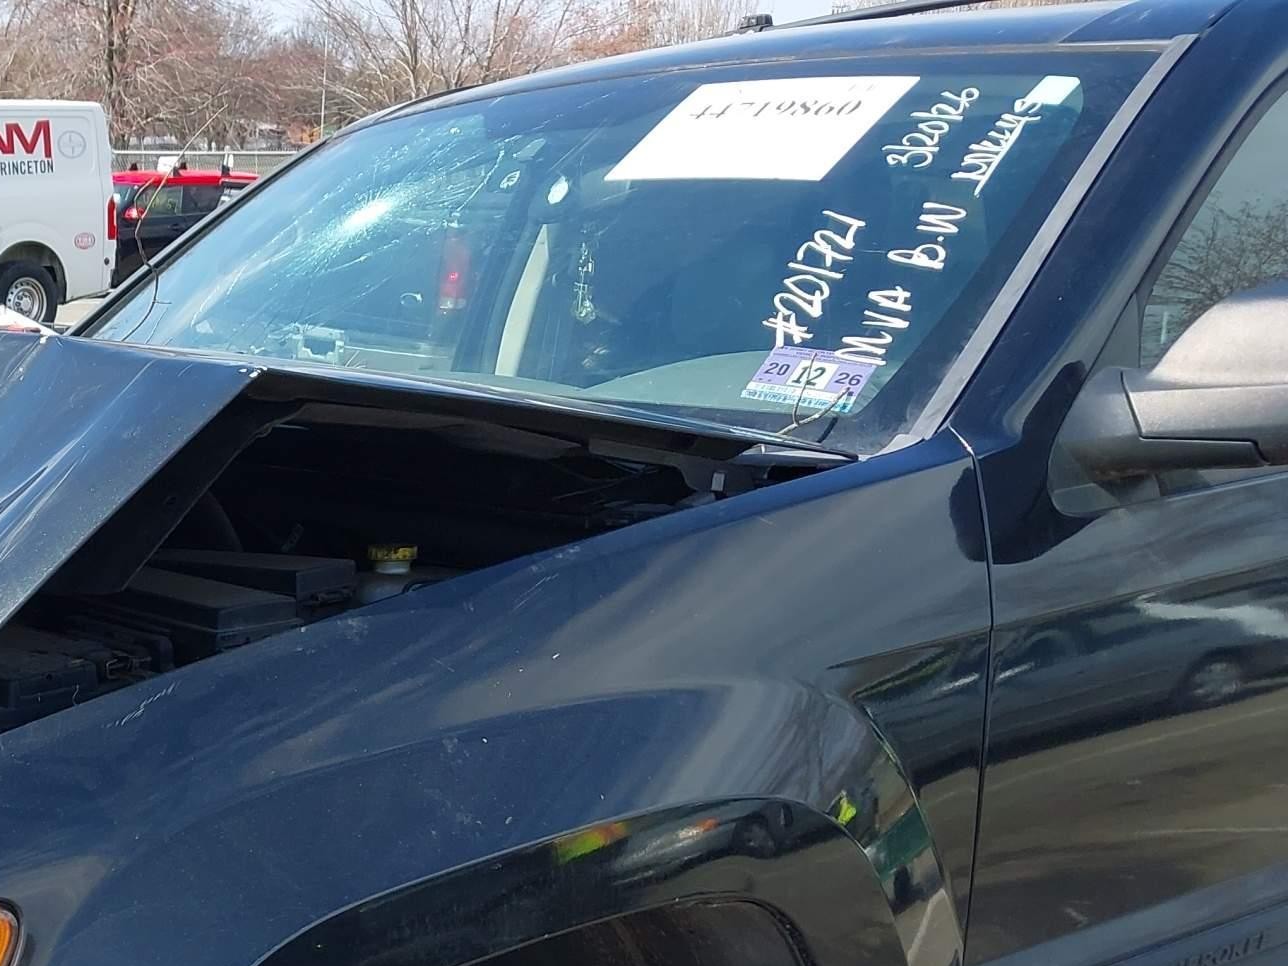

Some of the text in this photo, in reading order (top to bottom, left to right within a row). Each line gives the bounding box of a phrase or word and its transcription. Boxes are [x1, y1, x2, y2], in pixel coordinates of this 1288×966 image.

[881, 87, 980, 168] 3/20/26
[834, 285, 912, 366] MVA
[764, 362, 791, 376] 20
[792, 365, 826, 387] 12
[834, 372, 863, 386] 26
